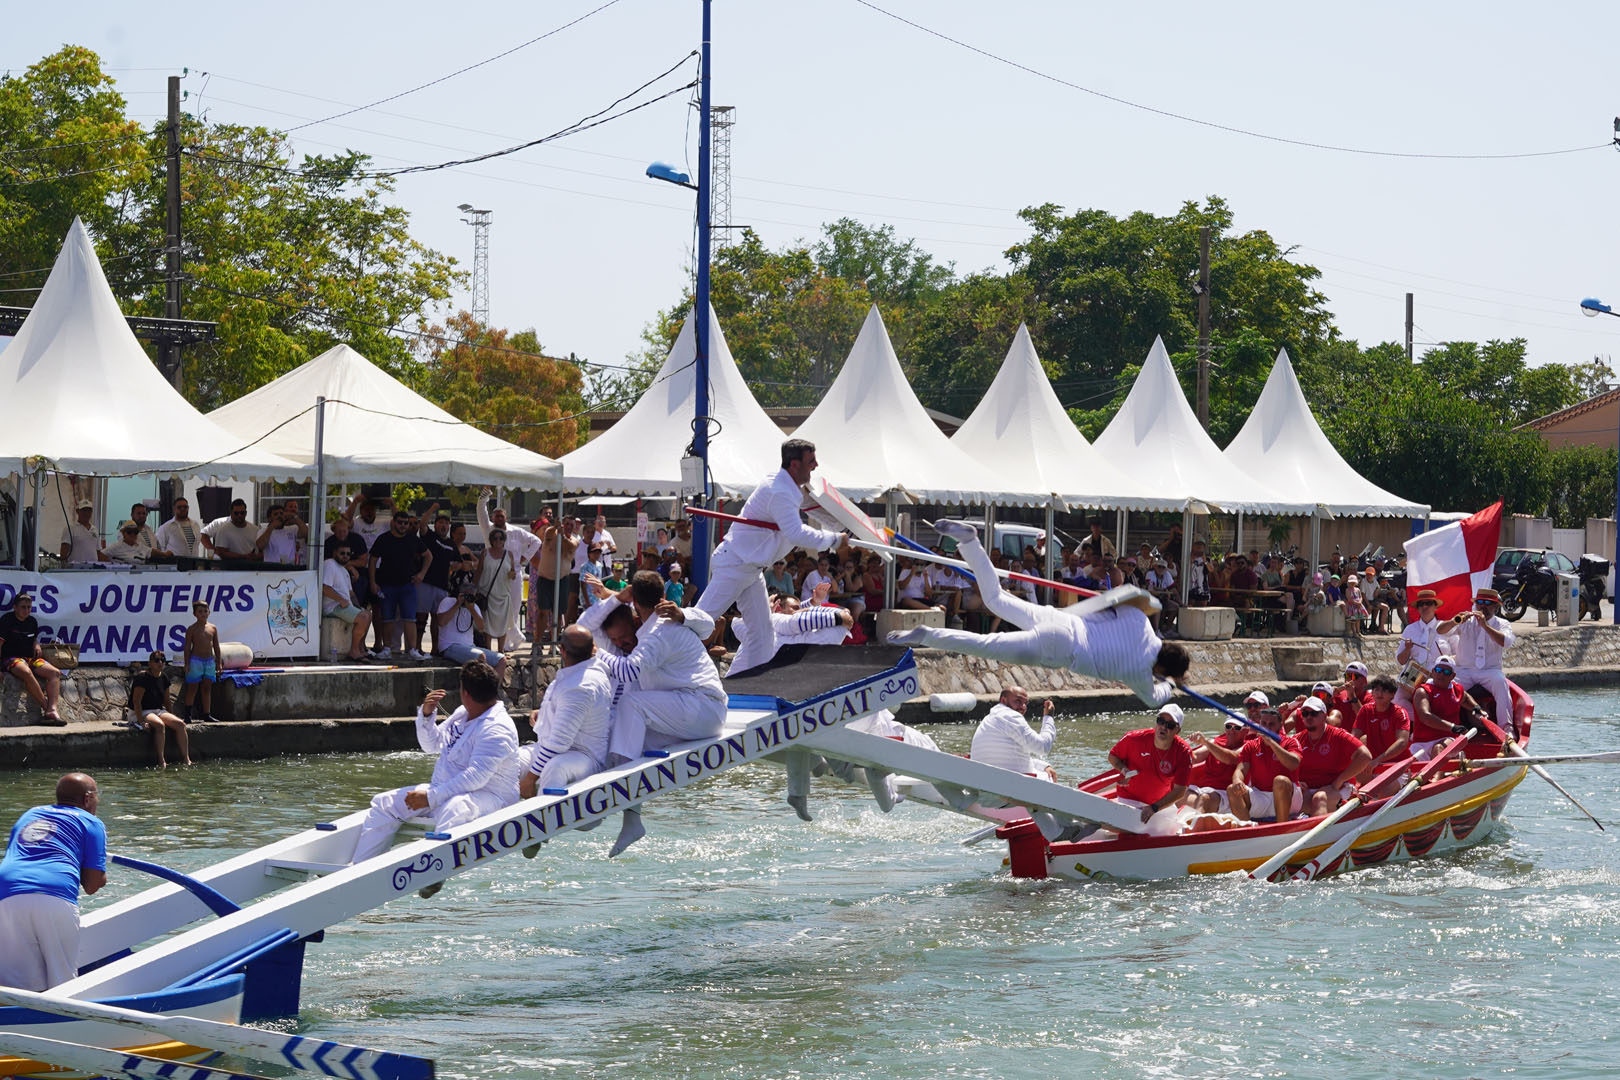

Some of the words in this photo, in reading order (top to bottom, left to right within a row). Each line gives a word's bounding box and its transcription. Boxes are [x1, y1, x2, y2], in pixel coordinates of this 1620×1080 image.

[0, 583, 59, 614] DES
[80, 583, 255, 614] JOUTEURS
[37, 625, 187, 653] GNANAIS
[449, 758, 677, 869] FRONTIGNAN
[687, 734, 747, 779] SON
[755, 687, 873, 752] MUSCAT
